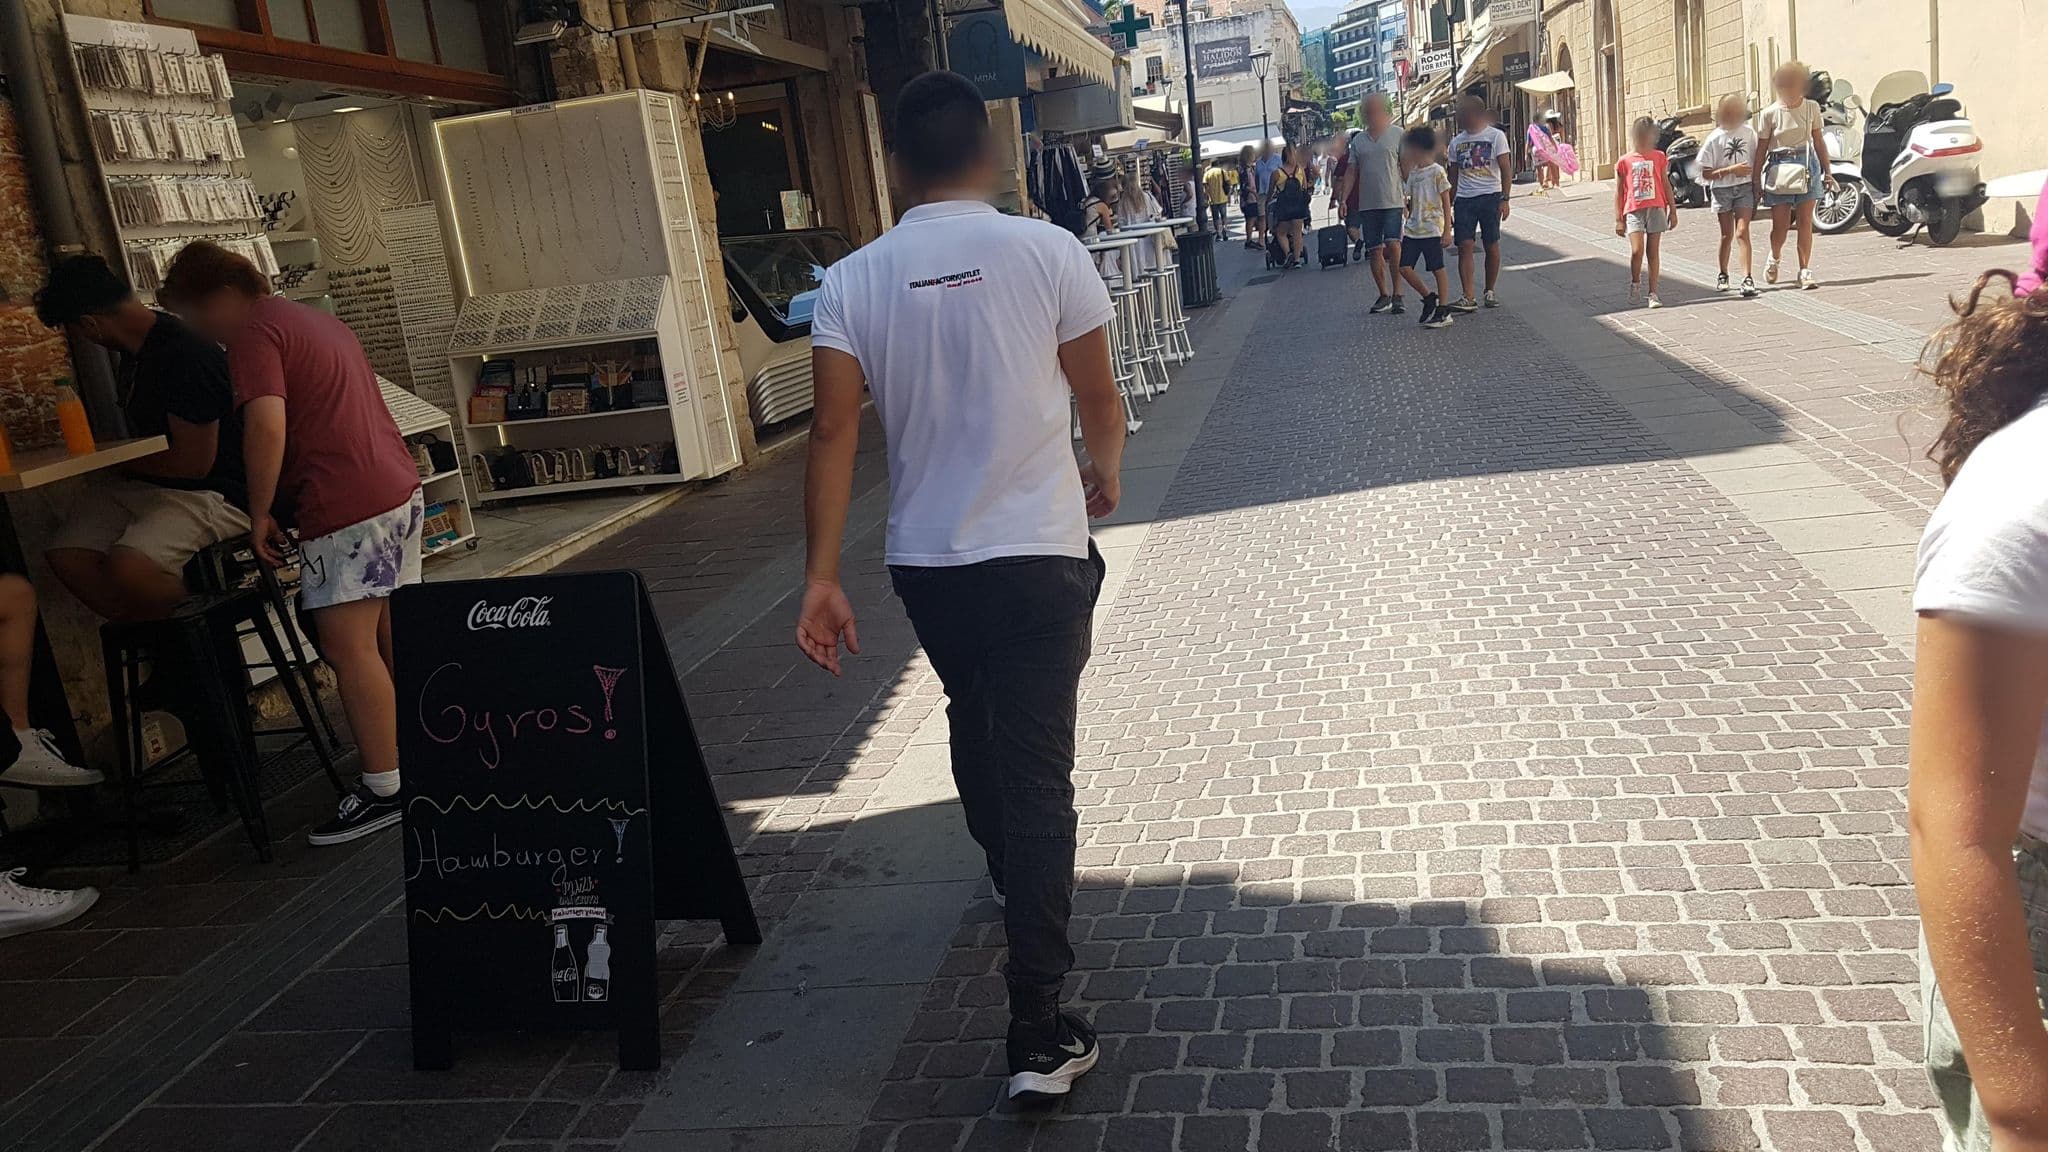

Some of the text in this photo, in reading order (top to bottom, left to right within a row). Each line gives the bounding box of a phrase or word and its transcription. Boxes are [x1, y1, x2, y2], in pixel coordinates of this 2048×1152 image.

[1203, 48, 1242, 62] HALIDON
[909, 268, 981, 290] ITALIANFACTORYOUTLET
[467, 595, 554, 631] Coca-Cola
[418, 662, 628, 770] Gyros!
